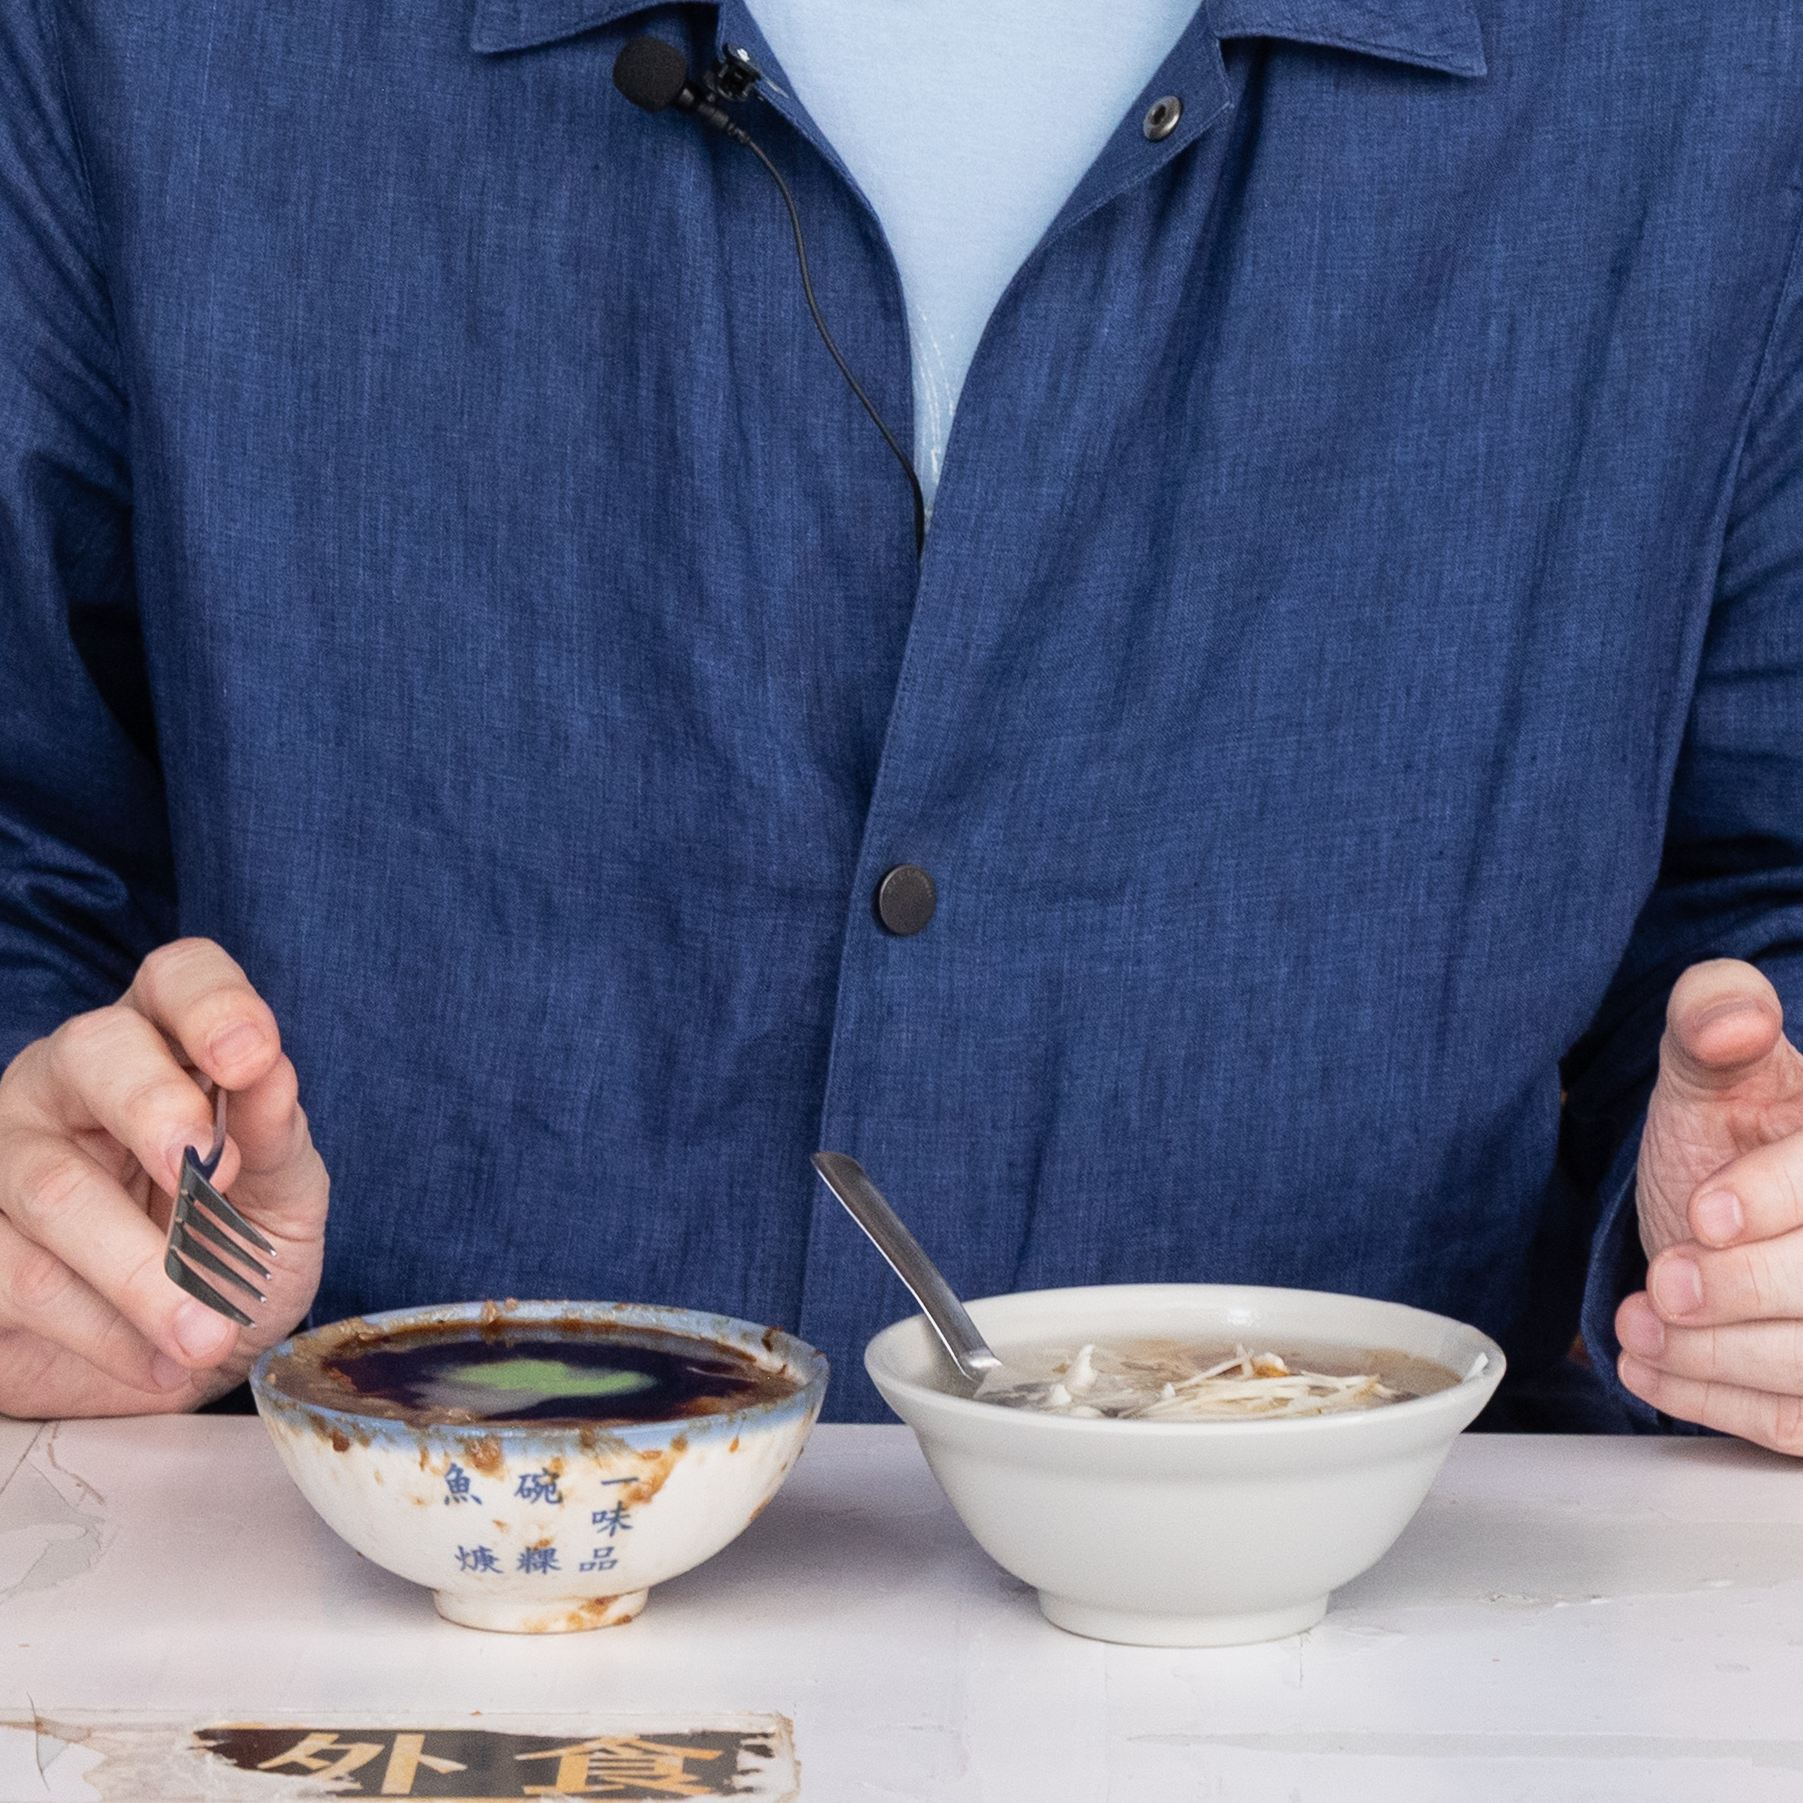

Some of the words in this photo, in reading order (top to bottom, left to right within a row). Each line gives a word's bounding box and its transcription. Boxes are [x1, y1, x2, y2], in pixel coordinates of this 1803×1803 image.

[514, 1466, 564, 1575] 碗粿
[579, 1476, 640, 1574] 一味品
